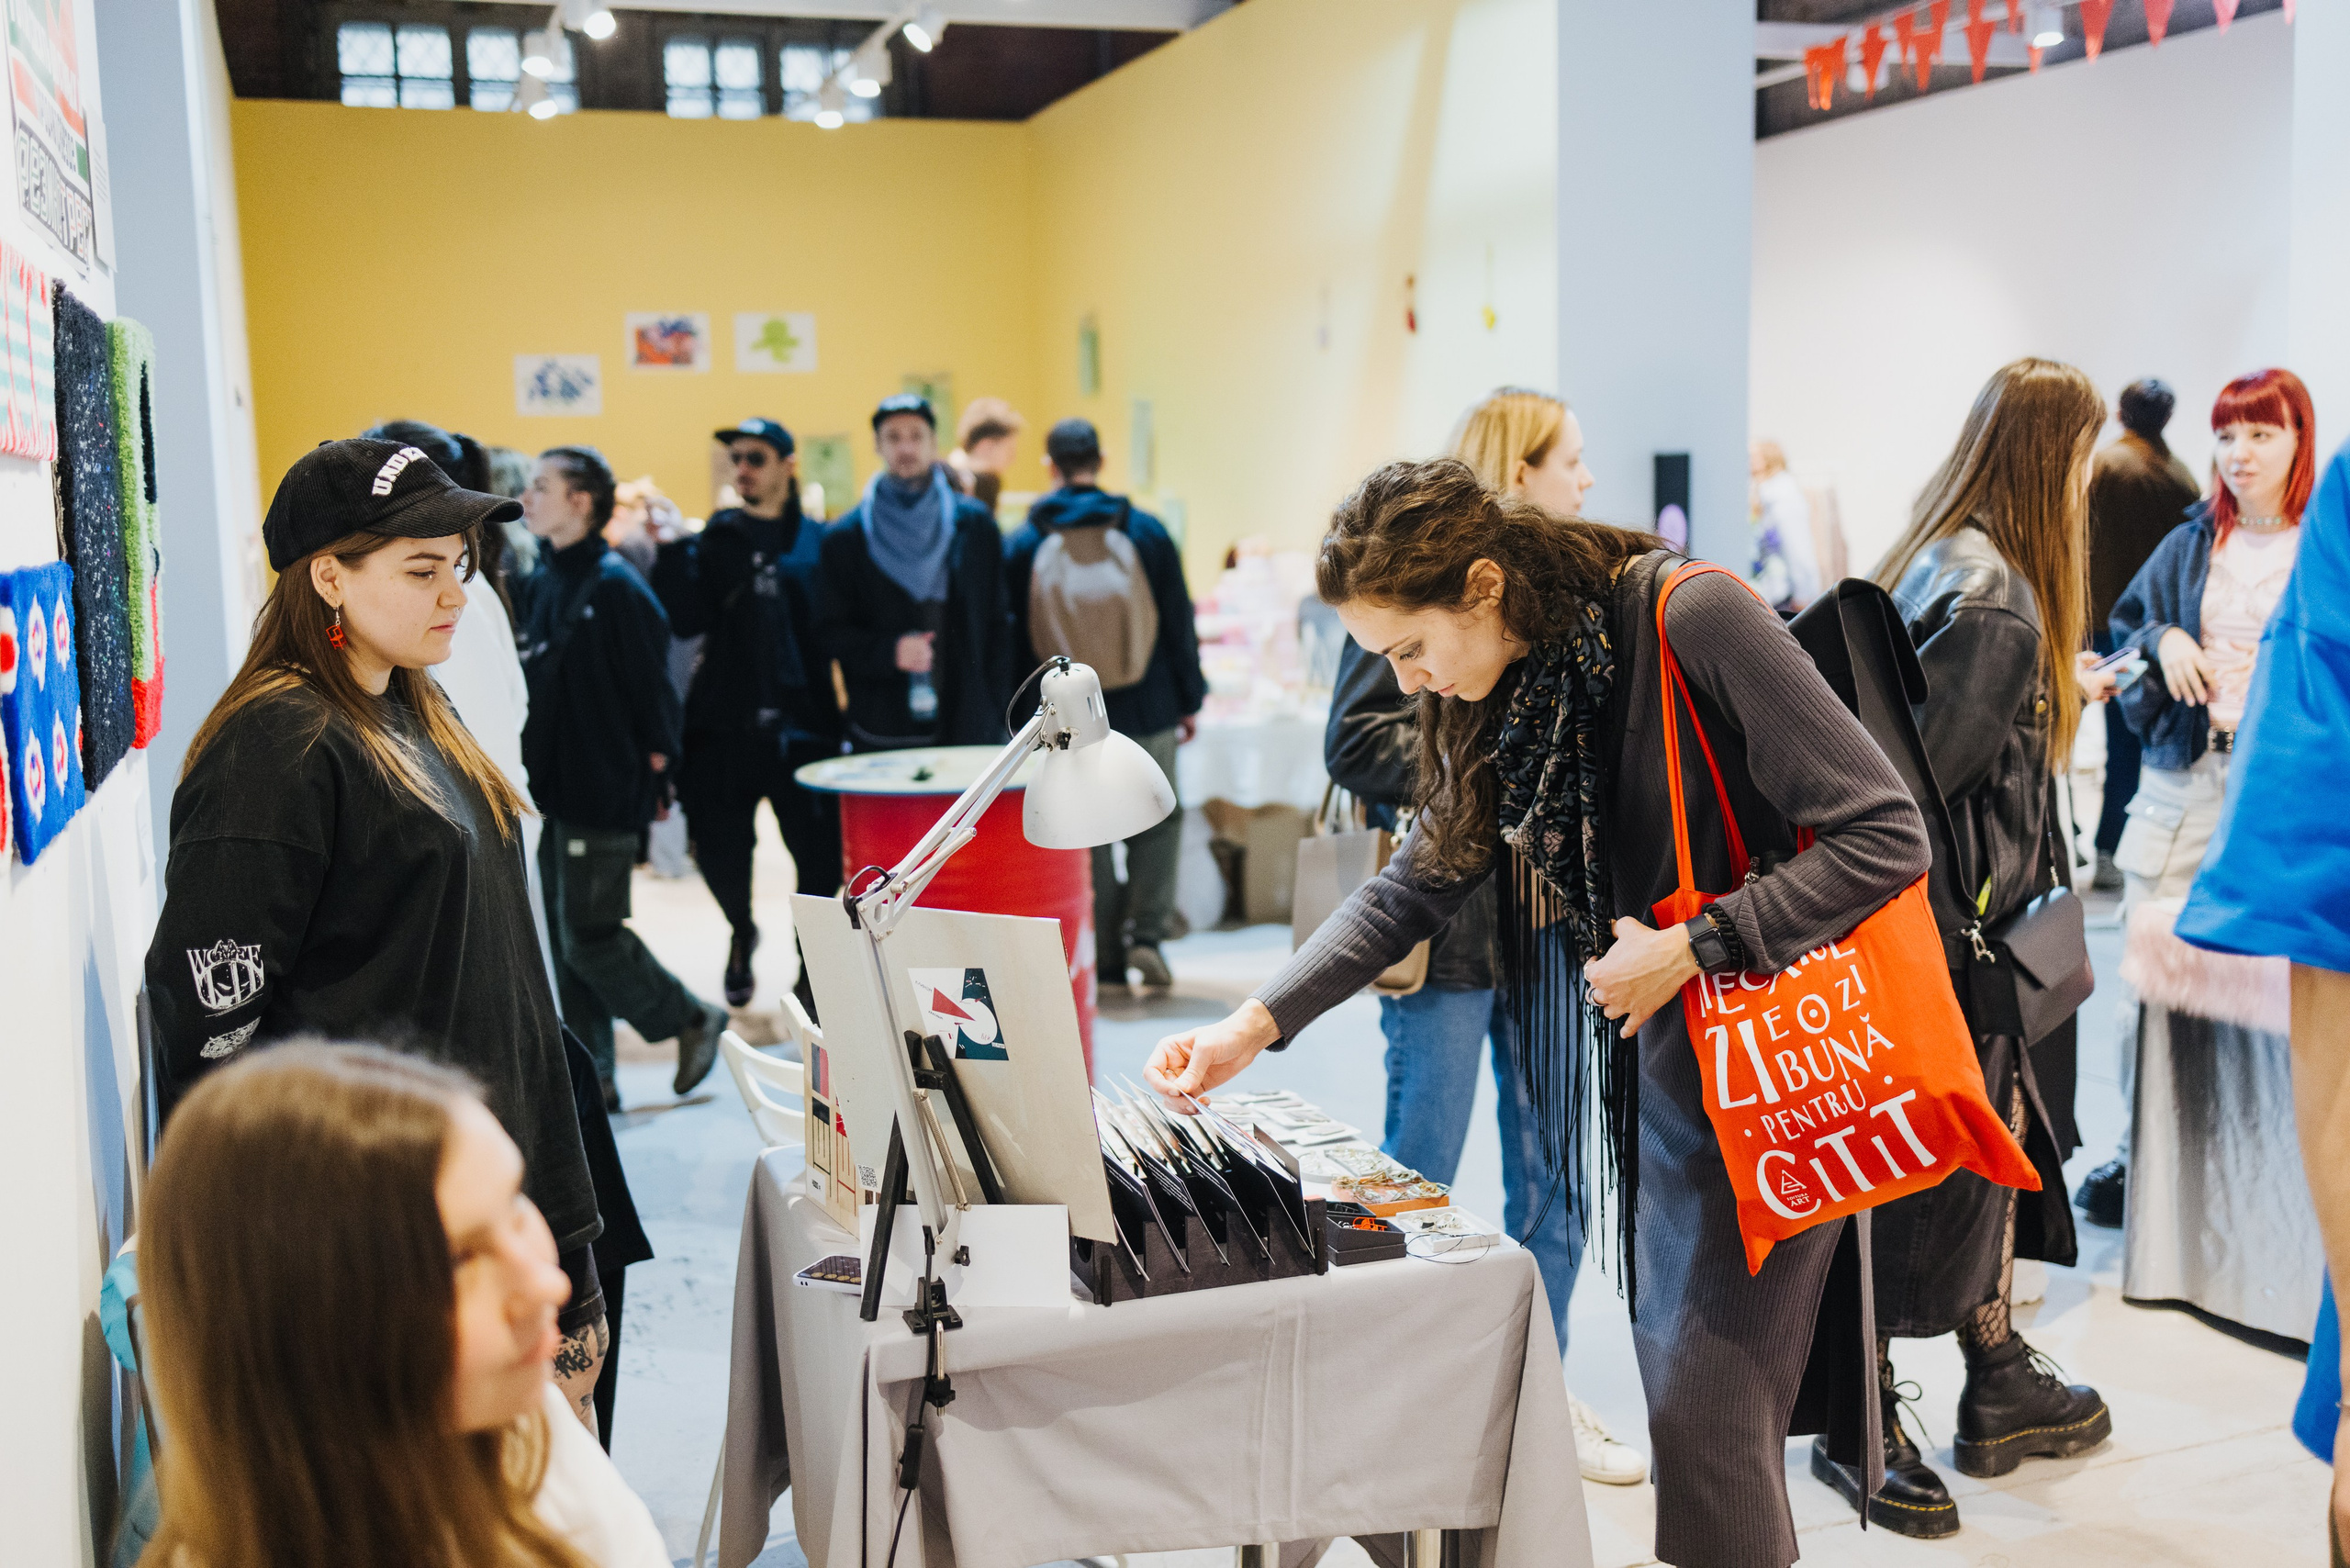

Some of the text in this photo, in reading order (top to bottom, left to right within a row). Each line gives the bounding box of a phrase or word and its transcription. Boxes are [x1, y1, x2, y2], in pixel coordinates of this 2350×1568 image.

[1762, 964, 1867, 1042] E O ZI
[1706, 1018, 1781, 1110] ZI
[1774, 1014, 1896, 1092] BUNĂ
[1760, 1079, 1867, 1144] PENTRU
[1791, 1195, 1810, 1207] ART
